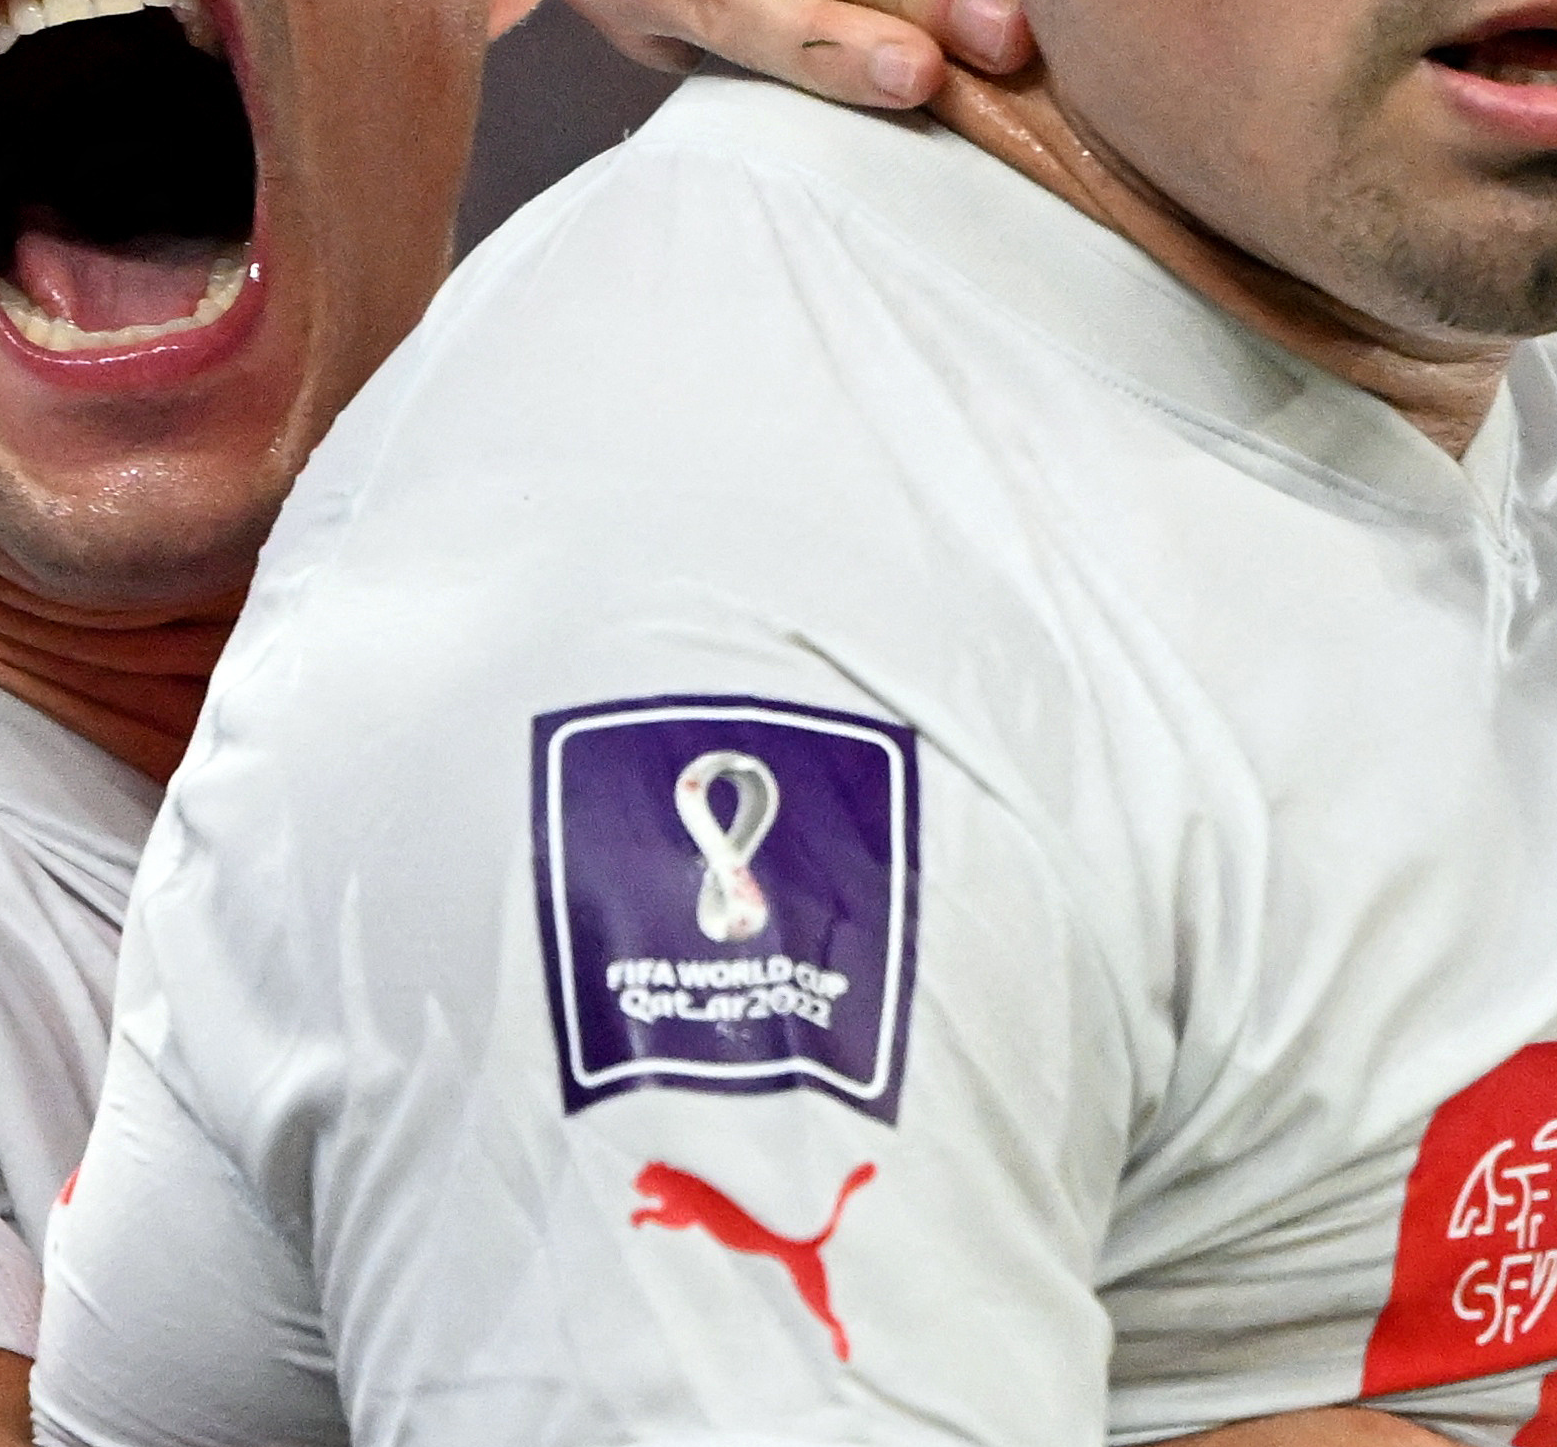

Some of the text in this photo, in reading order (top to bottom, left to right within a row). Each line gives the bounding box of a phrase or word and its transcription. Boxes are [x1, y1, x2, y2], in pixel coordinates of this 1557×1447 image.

[606, 954, 849, 1002] FIFA WORLD CUP
